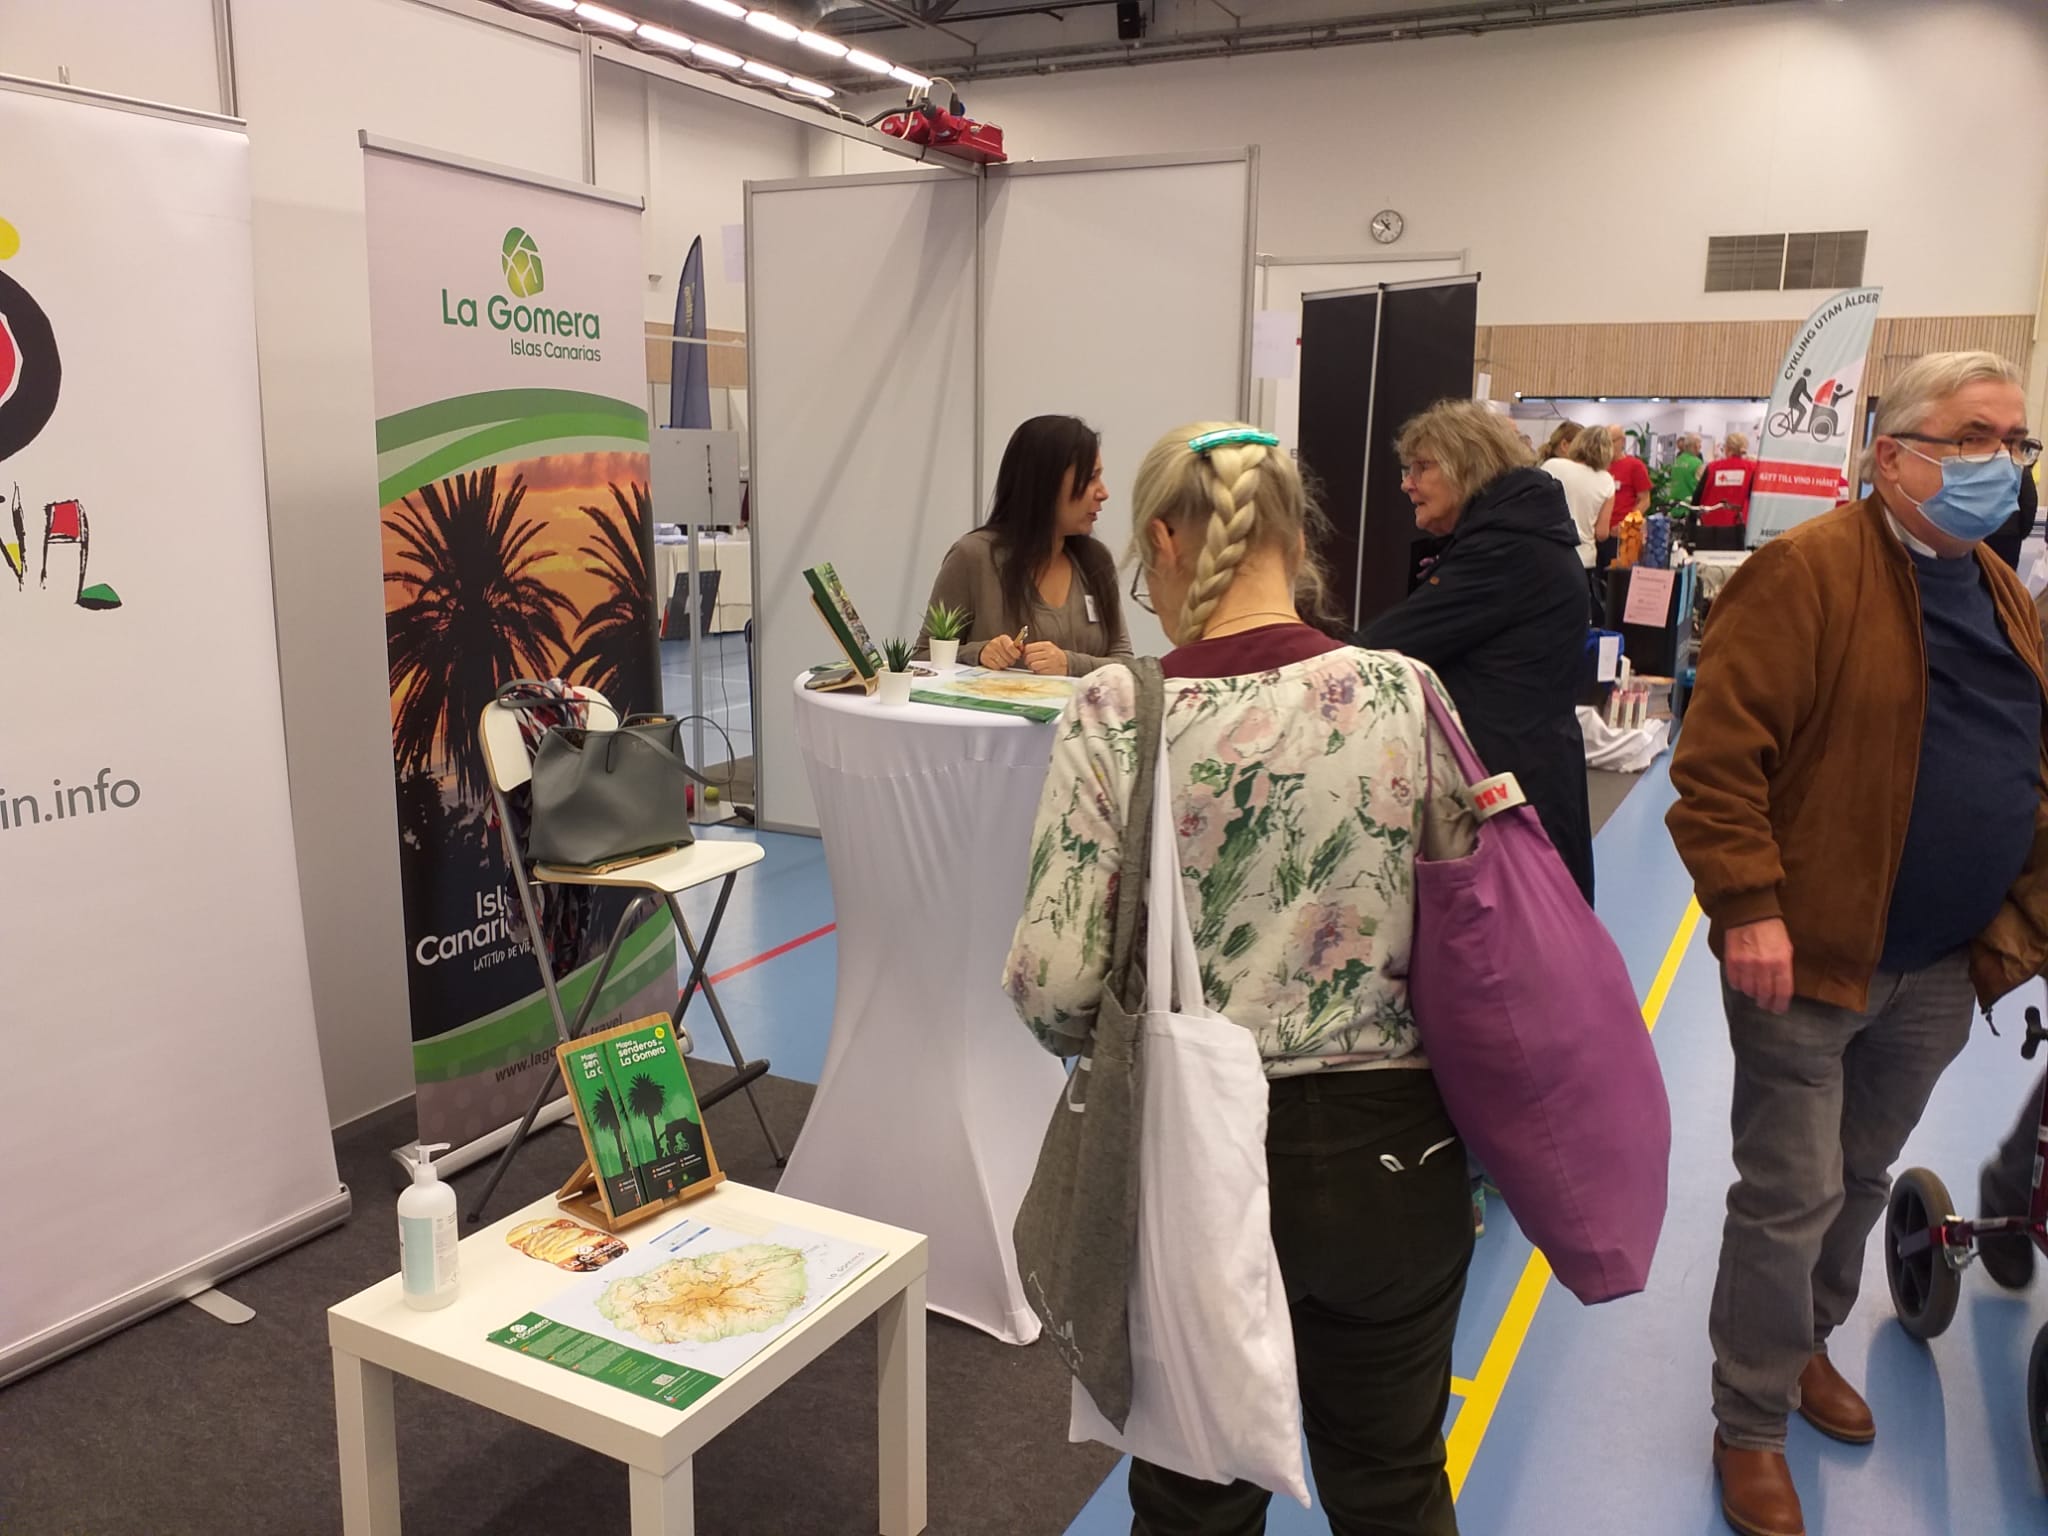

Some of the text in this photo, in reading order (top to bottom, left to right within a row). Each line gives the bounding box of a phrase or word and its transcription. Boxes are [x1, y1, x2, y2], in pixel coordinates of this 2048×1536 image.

[442, 288, 601, 340] La Gomera
[510, 338, 601, 362] Islas Canarias
[1784, 328, 1817, 380] CYKLING
[1814, 303, 1843, 330] UTAN
[476, 885, 507, 920] Isl
[416, 911, 510, 966] Canari
[473, 949, 506, 972] LATITUD
[507, 944, 518, 960] DE
[617, 1039, 658, 1057] senderos
[620, 1046, 666, 1067] La Gomera
[584, 1067, 597, 1079] La
